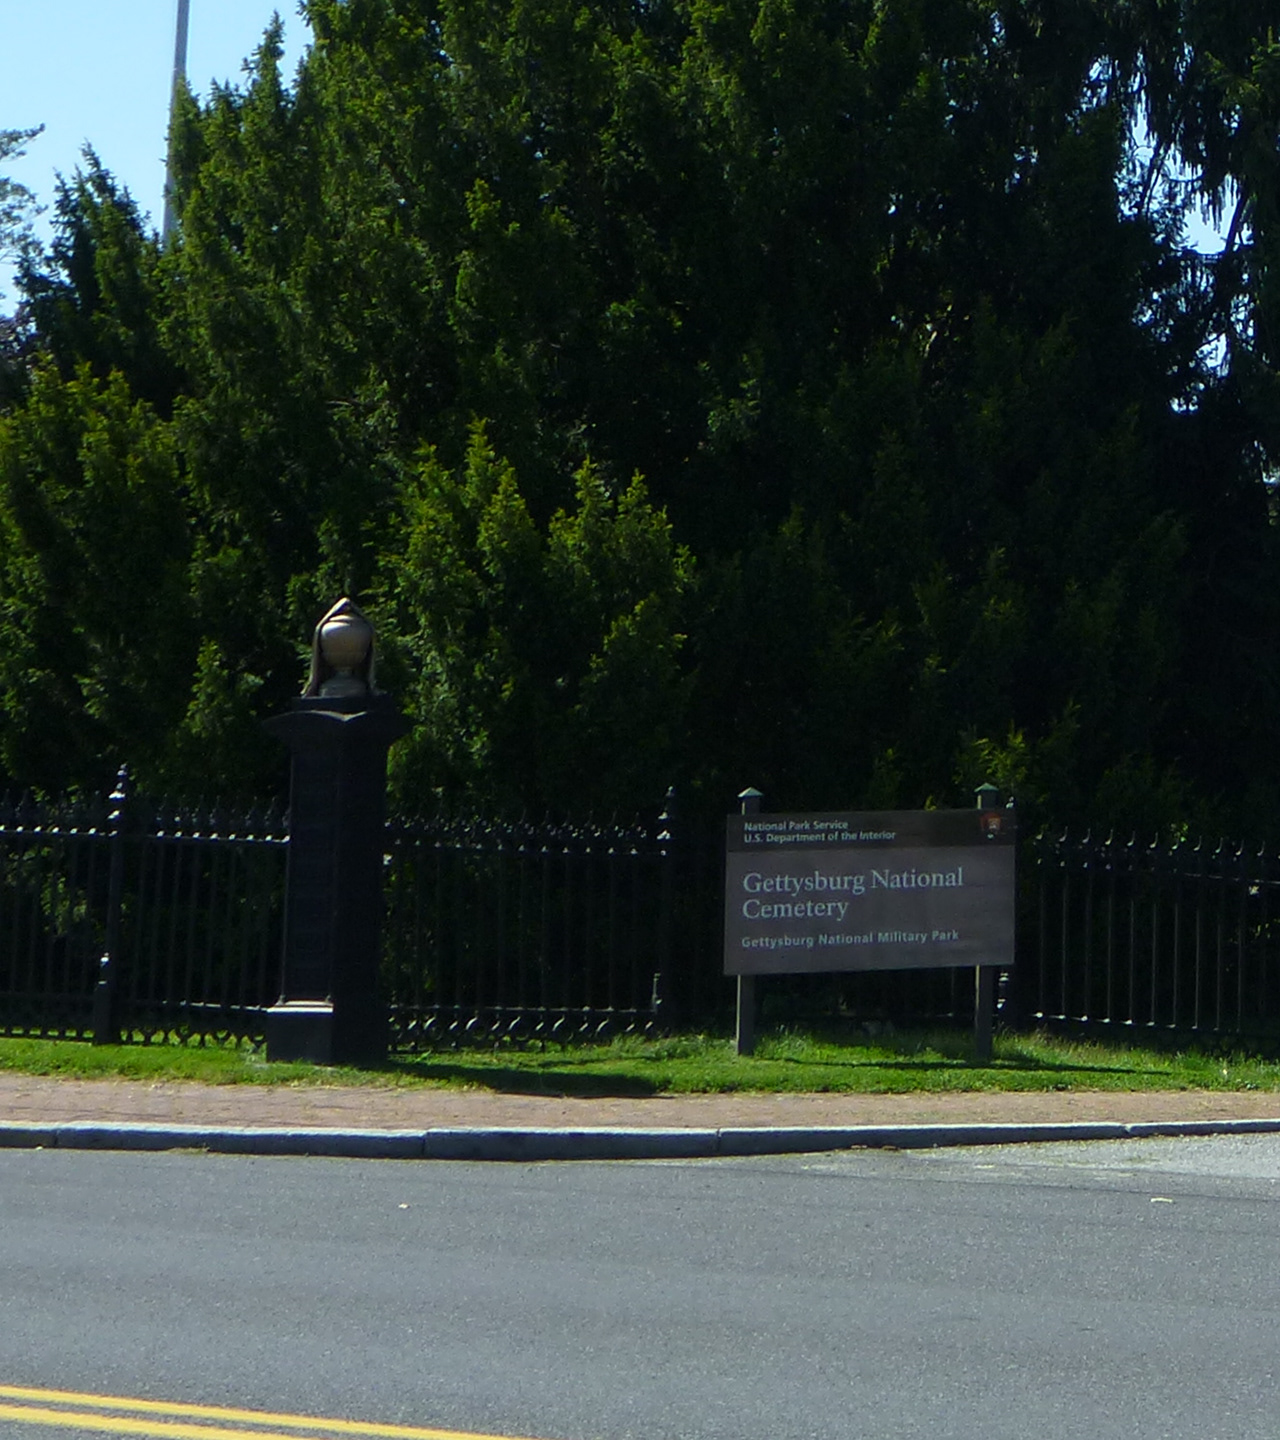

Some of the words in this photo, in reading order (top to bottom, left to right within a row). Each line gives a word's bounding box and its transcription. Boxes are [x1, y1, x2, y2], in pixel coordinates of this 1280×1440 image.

[744, 821, 787, 832] National
[788, 820, 811, 830] Park
[813, 819, 849, 830] Service
[744, 833, 764, 844] U.S.
[766, 831, 826, 844] Department
[827, 831, 839, 841] of
[840, 831, 858, 841] the
[859, 829, 897, 840] Interior
[742, 869, 866, 897] Gettysburg
[871, 866, 965, 891] National
[741, 898, 850, 921] Cemetery
[741, 935, 815, 949] Gettysburg
[818, 933, 874, 945] National
[877, 932, 929, 944] Military
[931, 929, 960, 941] Park
